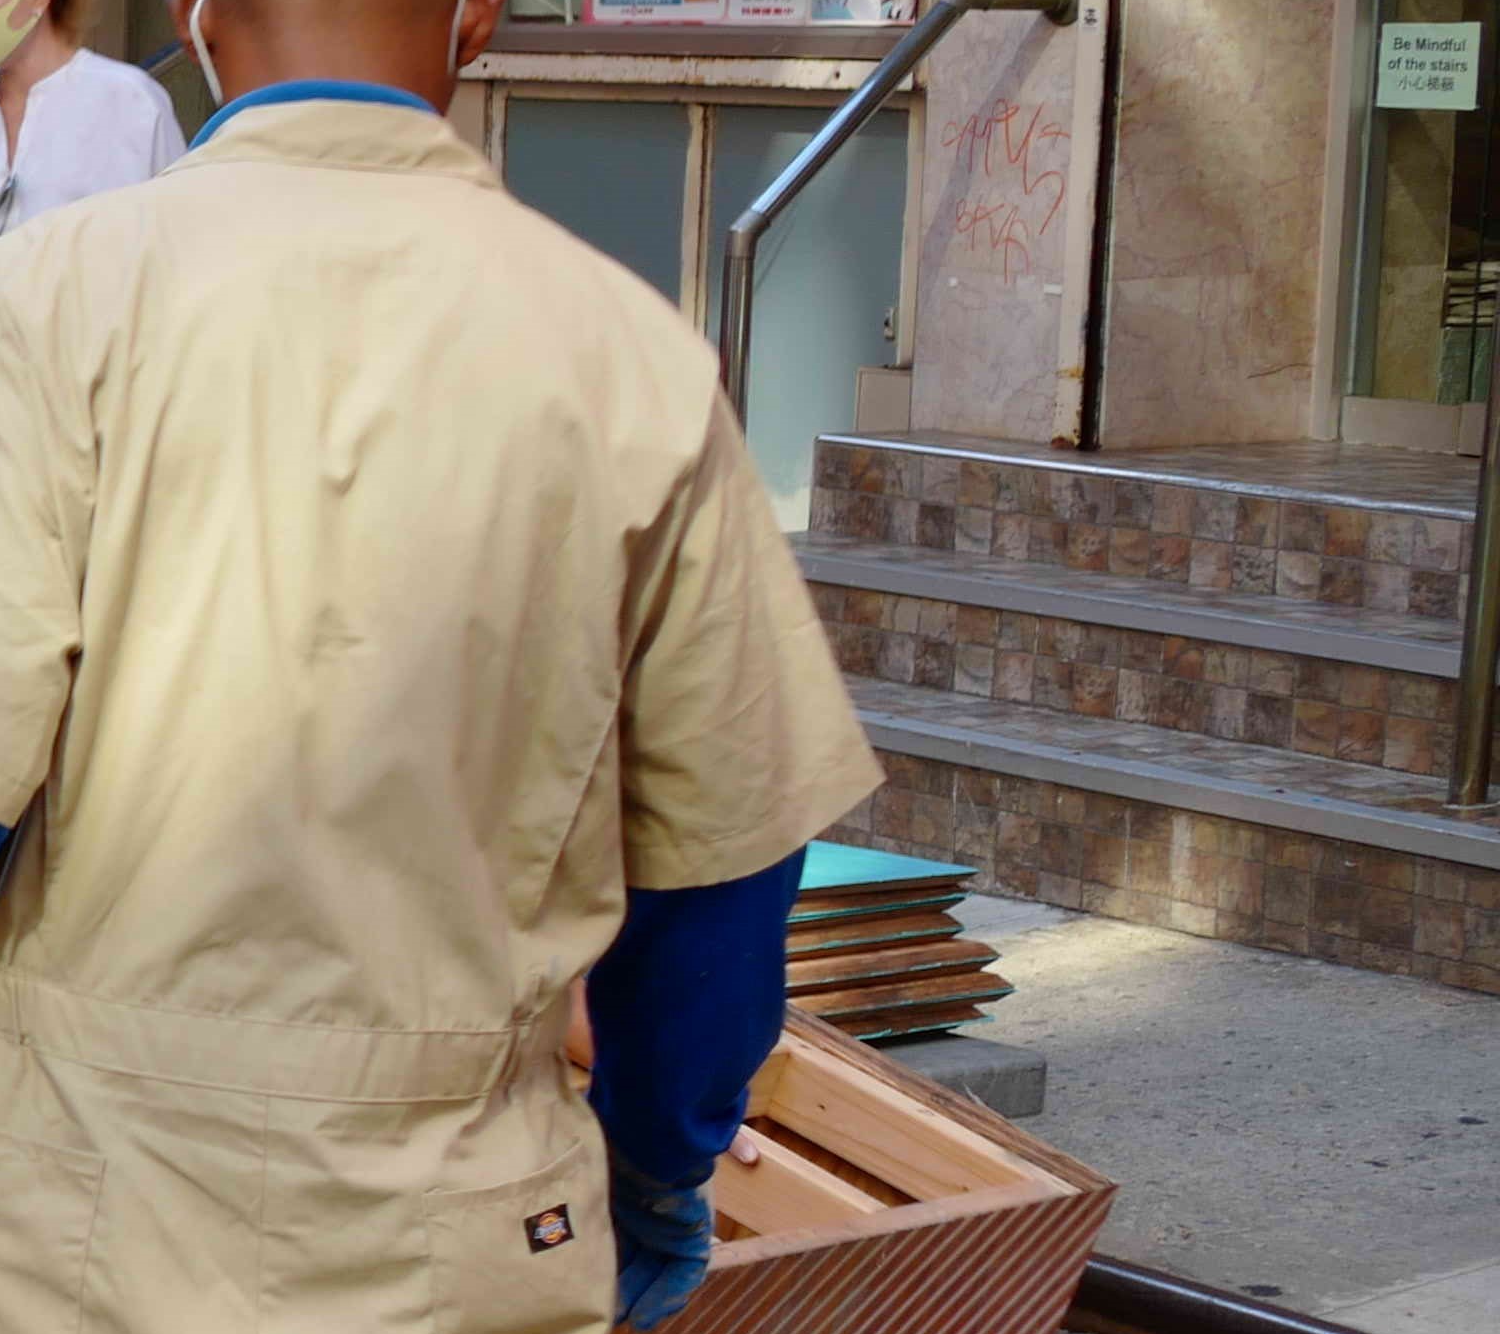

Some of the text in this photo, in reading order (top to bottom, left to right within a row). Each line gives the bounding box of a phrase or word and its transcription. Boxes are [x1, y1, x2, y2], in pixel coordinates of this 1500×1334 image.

[1393, 37, 1468, 53] Be Mindful
[1387, 57, 1468, 73] of the stairs
